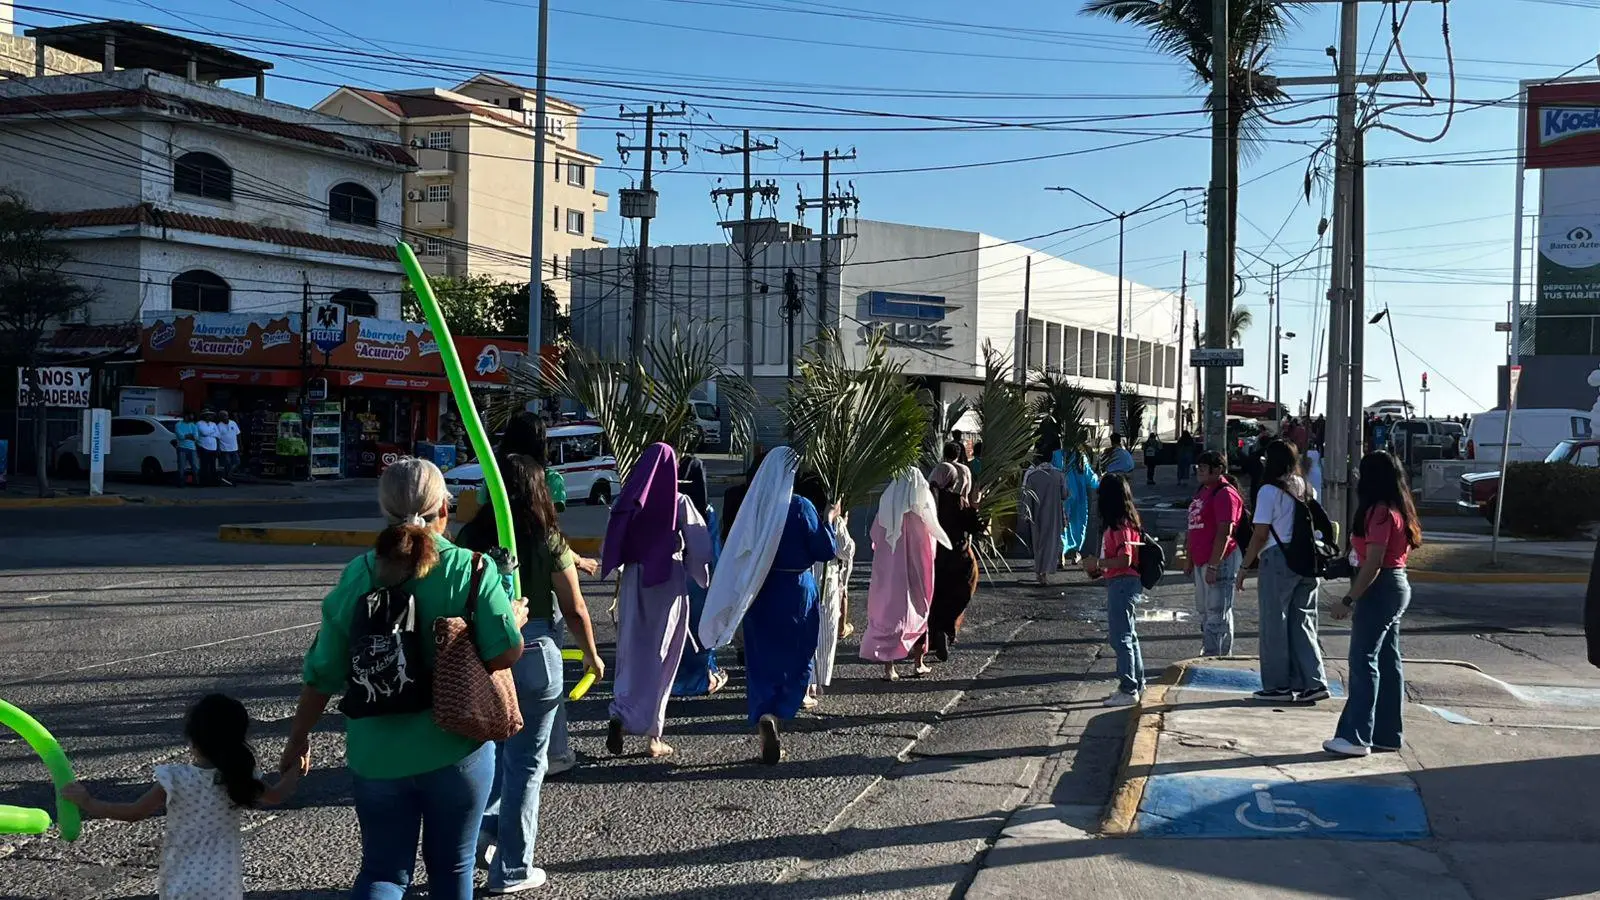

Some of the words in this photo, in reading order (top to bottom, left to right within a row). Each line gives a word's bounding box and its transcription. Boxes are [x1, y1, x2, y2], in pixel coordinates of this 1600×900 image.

[194, 324, 246, 336] Abarrotes
[312, 330, 341, 342] TECATE
[360, 328, 406, 342] Abarrotes
[20, 388, 88, 405] RADERAS
